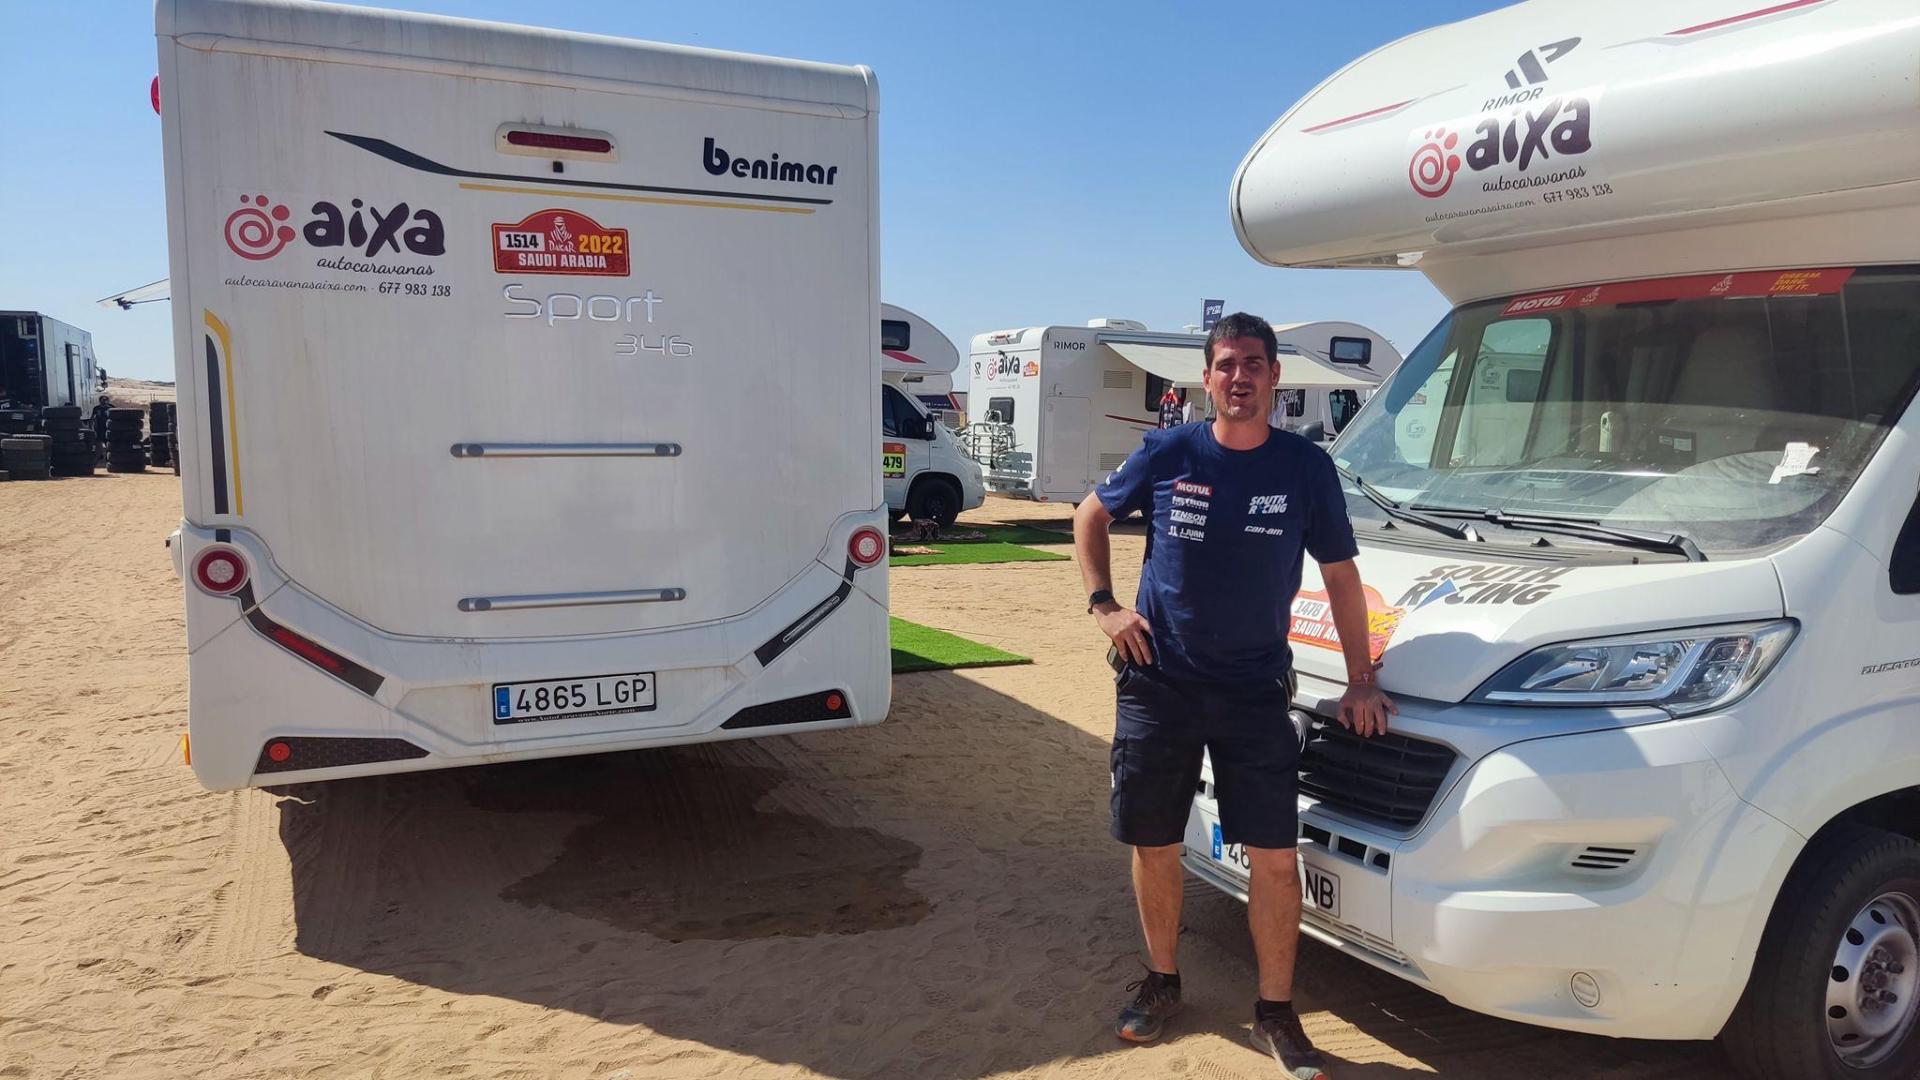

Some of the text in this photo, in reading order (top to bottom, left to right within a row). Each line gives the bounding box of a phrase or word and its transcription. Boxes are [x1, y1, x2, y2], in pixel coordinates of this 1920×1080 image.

[1482, 88, 1544, 112] RIMOR
[1466, 97, 1592, 171] aixa
[703, 137, 838, 185] benimar
[1482, 166, 1586, 192] autocaravanas
[1425, 183, 1613, 223] autocaravanasaixa.com 677 983 138
[303, 198, 446, 257] aixa
[506, 234, 539, 248] 1514
[549, 240, 576, 253] DAKAR
[579, 234, 623, 254] 2022
[317, 255, 435, 275] autocaravanas
[518, 253, 607, 269] SAUDI ARABIA
[225, 275, 367, 293] autocaravanasaixa.com
[379, 281, 401, 294] 677
[405, 282, 427, 296] 983
[432, 284, 451, 297] 138
[503, 284, 663, 327] Sport
[1507, 295, 1566, 313] MOTUL
[615, 334, 694, 357] 346
[1054, 342, 1086, 351] RIMOR
[1176, 483, 1211, 496] MOTUL
[1249, 495, 1287, 506] SOUTH
[1244, 525, 1283, 536] can-am
[1414, 565, 1576, 583] SOUTH
[1294, 600, 1324, 617] 1478
[1292, 619, 1326, 639] SAUDI
[517, 684, 586, 712] 4865
[597, 679, 646, 706] LGP
[1305, 869, 1334, 909] NB
